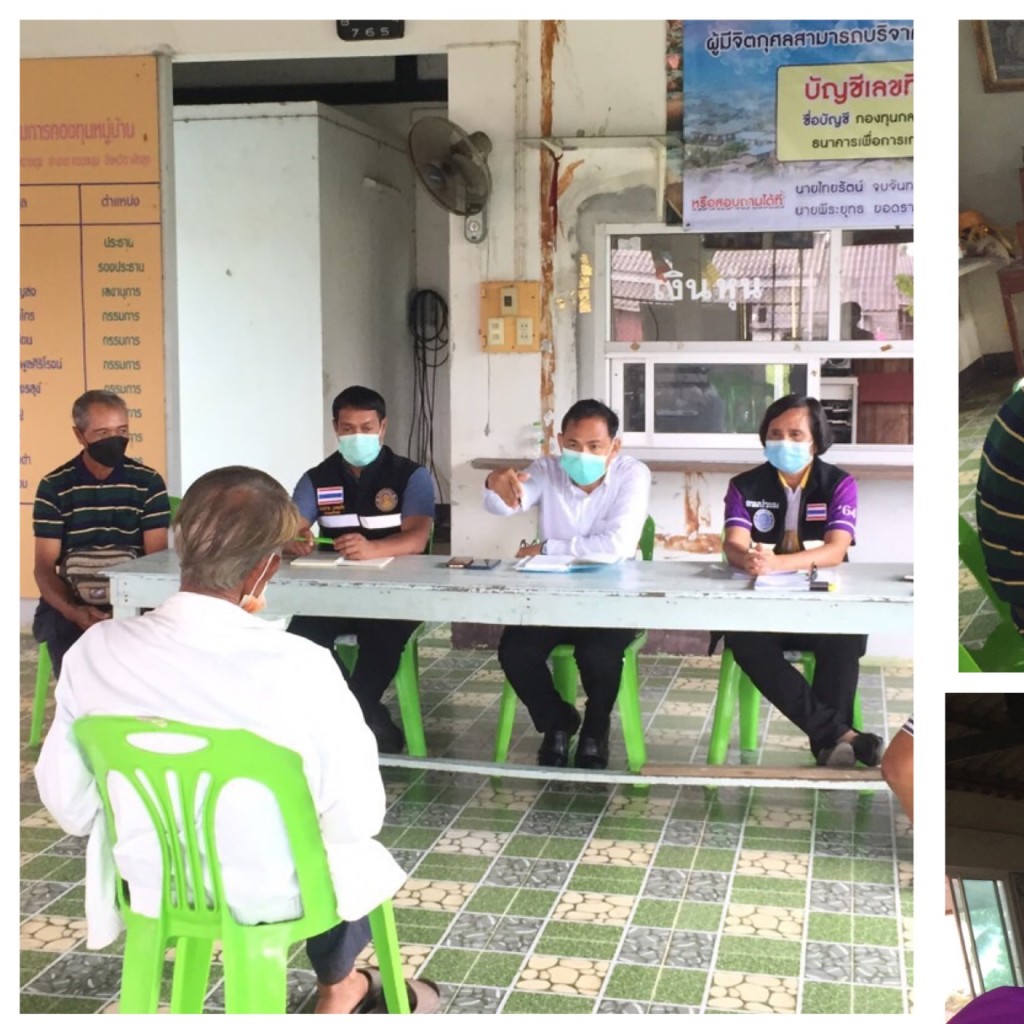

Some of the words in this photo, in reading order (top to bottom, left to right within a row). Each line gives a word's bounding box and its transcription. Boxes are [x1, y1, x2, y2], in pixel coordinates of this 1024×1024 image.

[706, 23, 914, 58] ผู้มีจิตกุศลสามารถบริจา
[802, 109, 850, 128] ชื่อบัญชี
